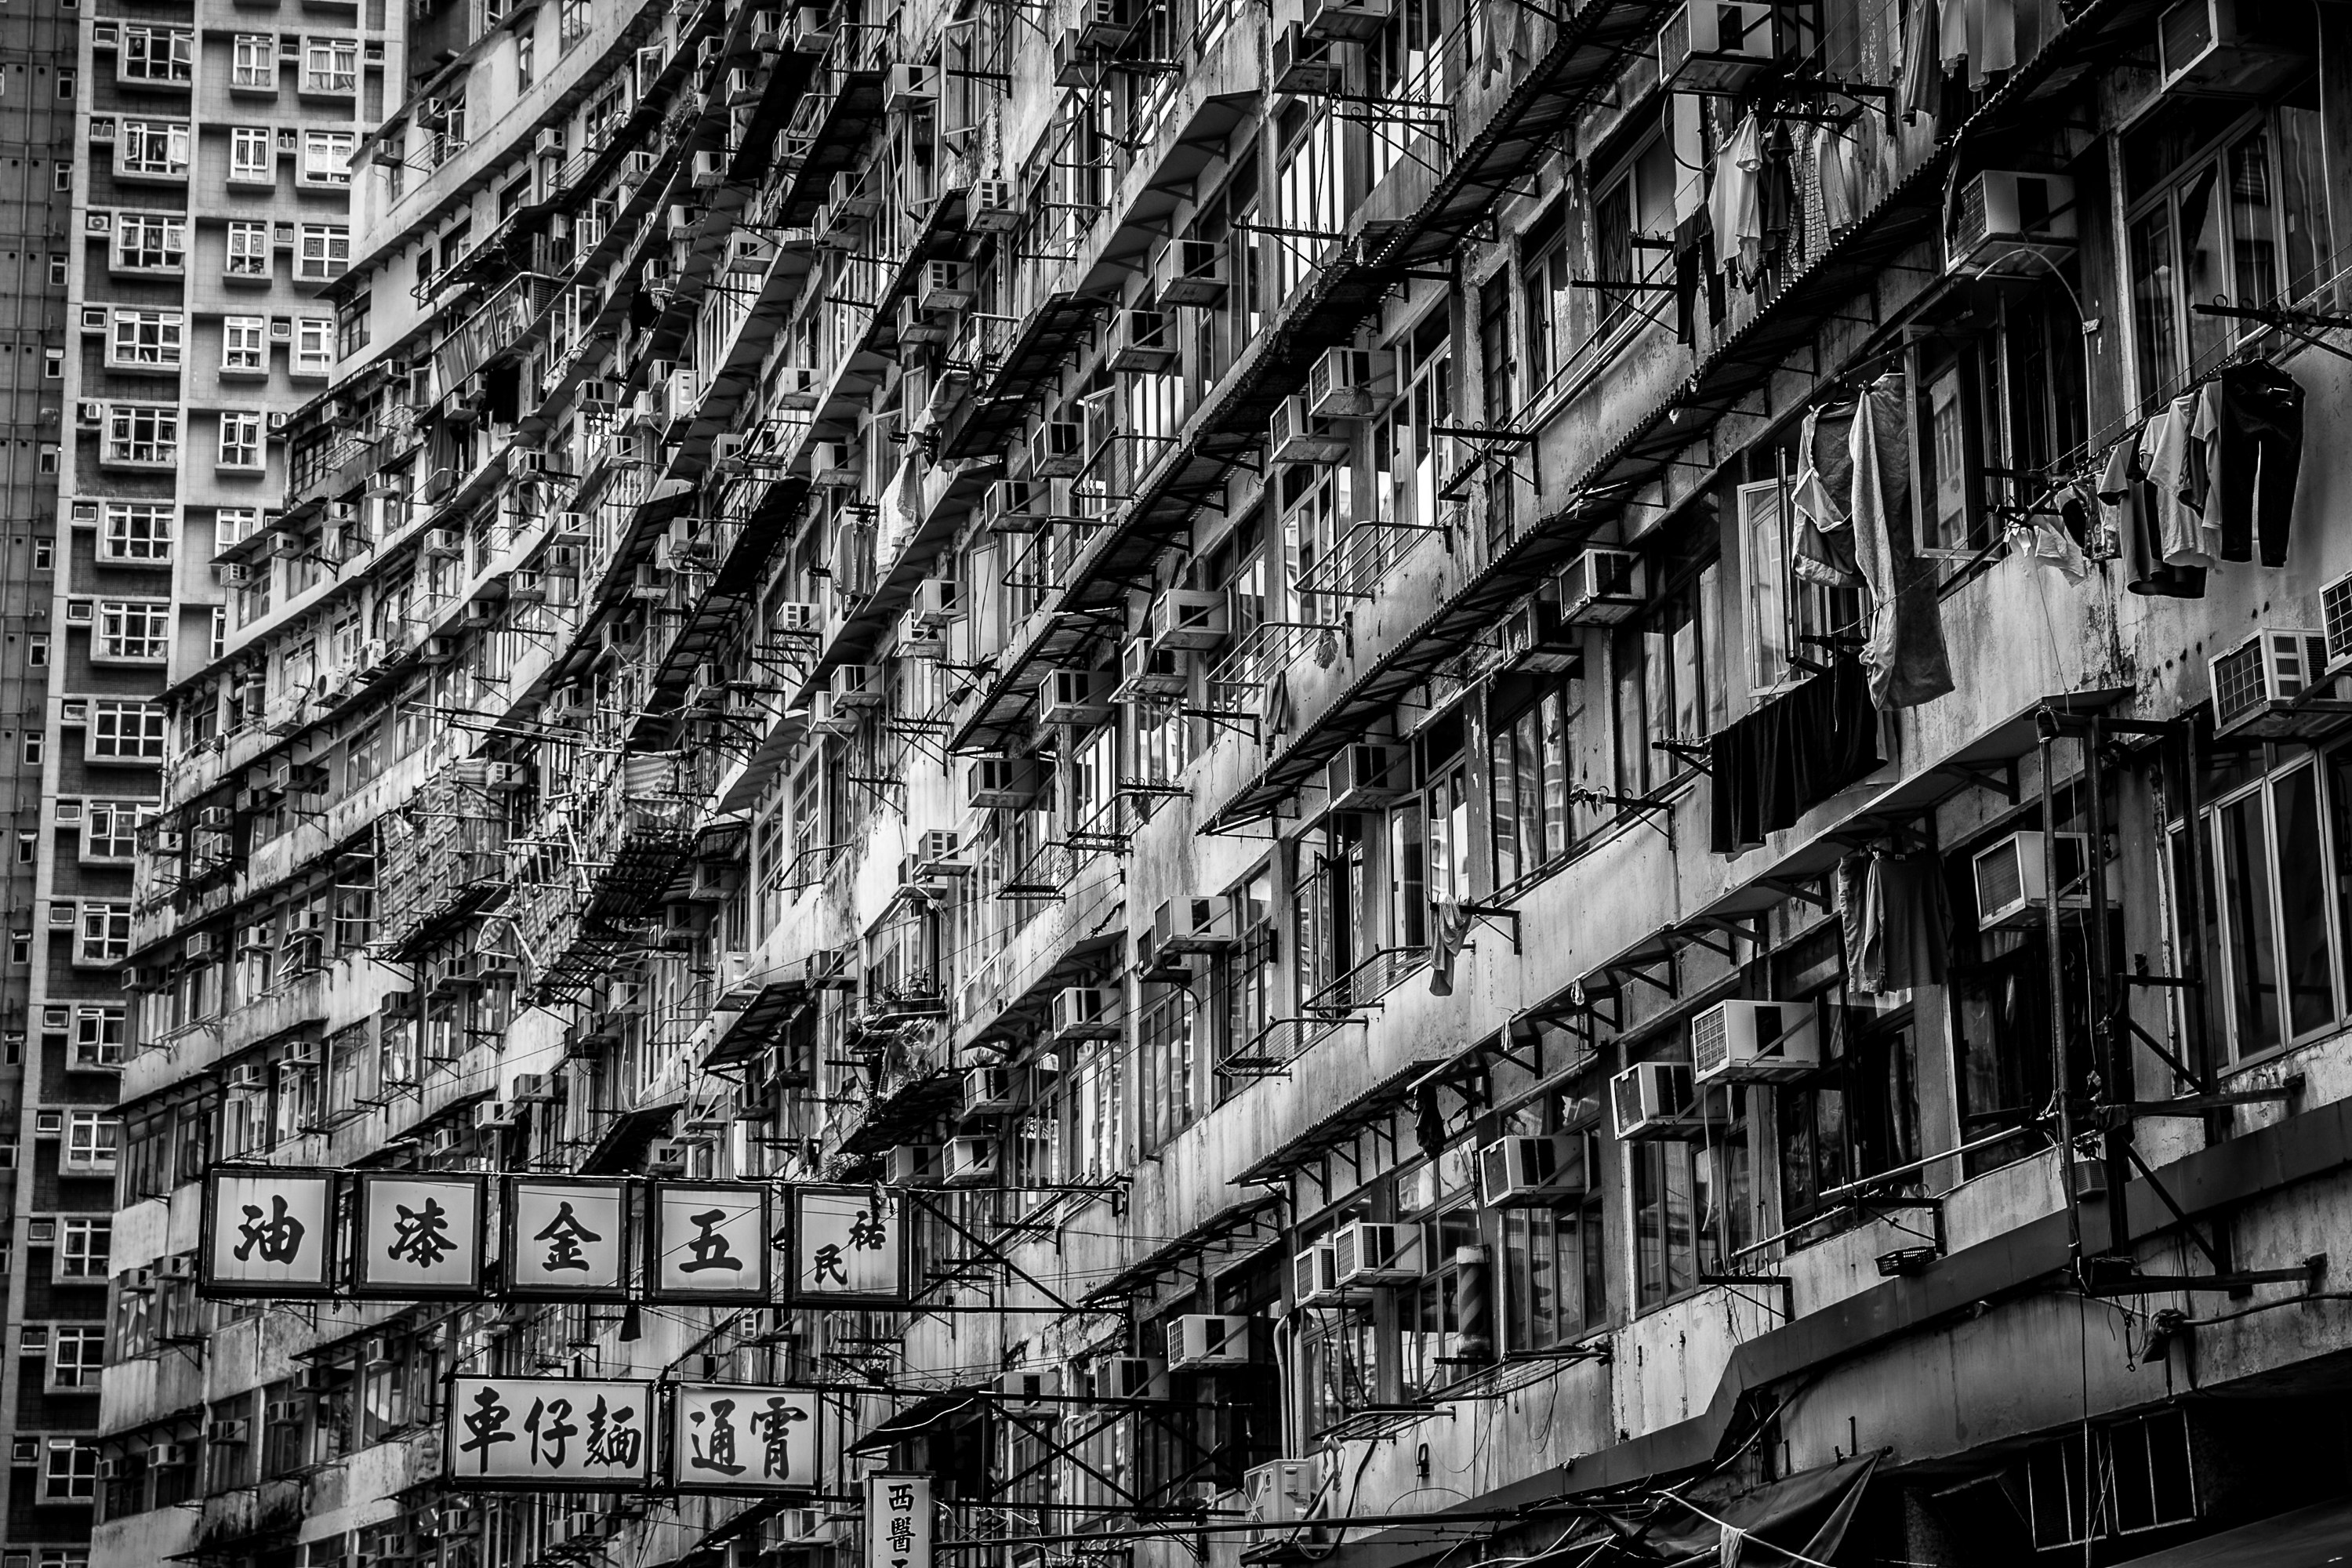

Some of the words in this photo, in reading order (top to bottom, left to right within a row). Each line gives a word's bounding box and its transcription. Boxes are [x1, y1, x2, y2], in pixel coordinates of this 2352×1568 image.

[459, 1386, 641, 1474] 車仔麵
[886, 1483, 916, 1568] 西醫
